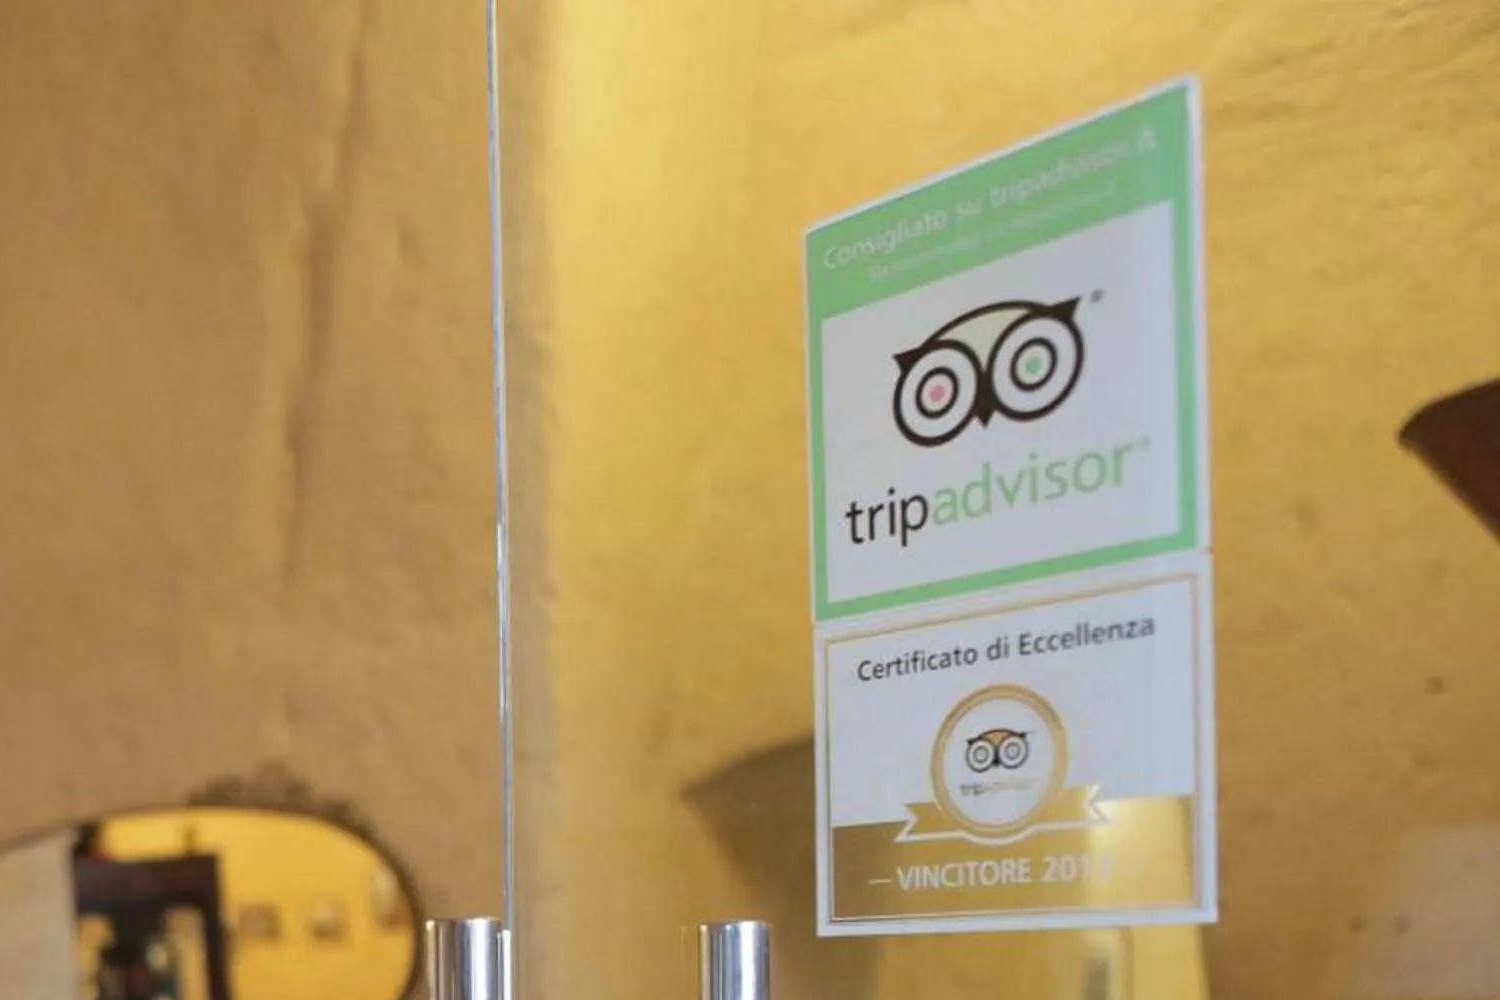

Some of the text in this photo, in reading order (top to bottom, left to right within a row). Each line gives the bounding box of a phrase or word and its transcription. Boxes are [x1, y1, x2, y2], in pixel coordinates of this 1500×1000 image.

[822, 206, 949, 270] Consigliato
[955, 199, 984, 222] su
[845, 442, 1133, 546] tripadvisor
[856, 614, 1156, 682] Certificato di Eccellenza
[896, 857, 1032, 891] VINCITORE
